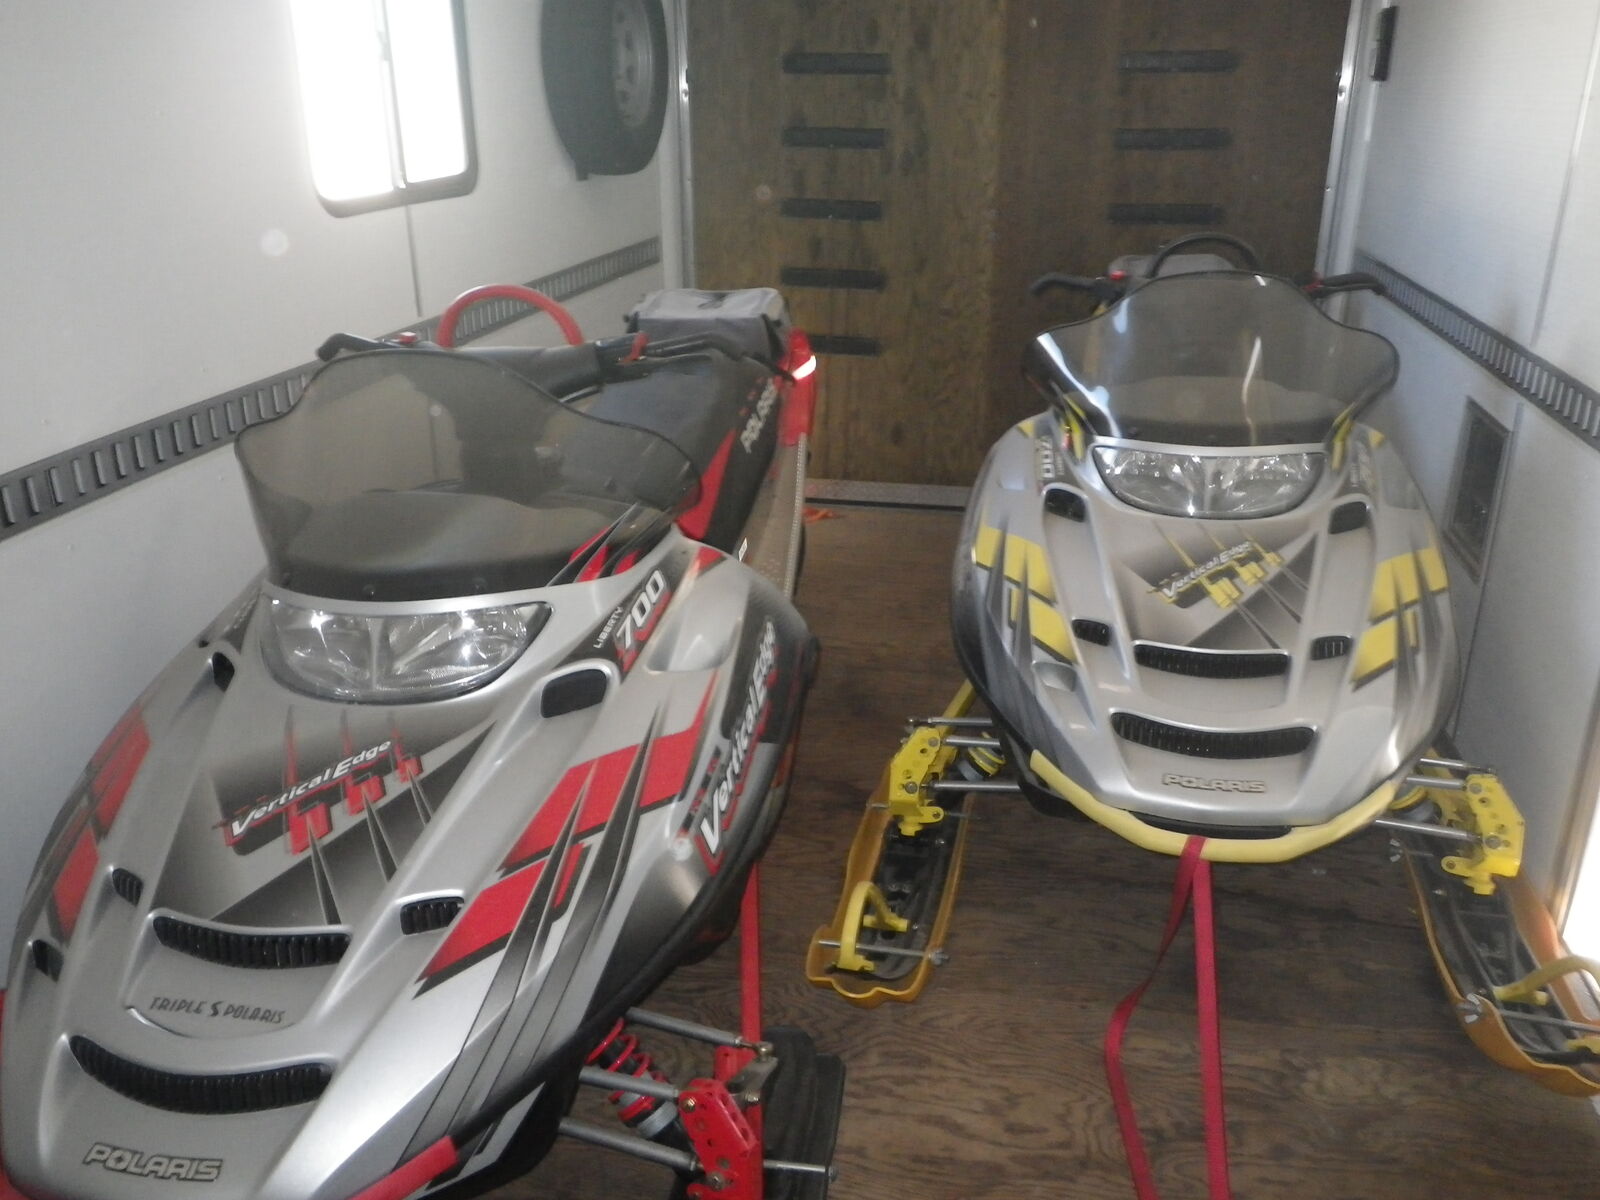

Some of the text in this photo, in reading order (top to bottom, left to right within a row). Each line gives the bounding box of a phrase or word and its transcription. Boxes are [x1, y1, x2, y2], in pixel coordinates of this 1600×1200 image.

[593, 606, 624, 649] LIBERTY
[616, 569, 668, 649] 700
[1162, 773, 1267, 794] POLARIS
[150, 996, 205, 1017] TRIPLE
[223, 1004, 287, 1025] POLARIS
[82, 1142, 223, 1182] POLARIS
